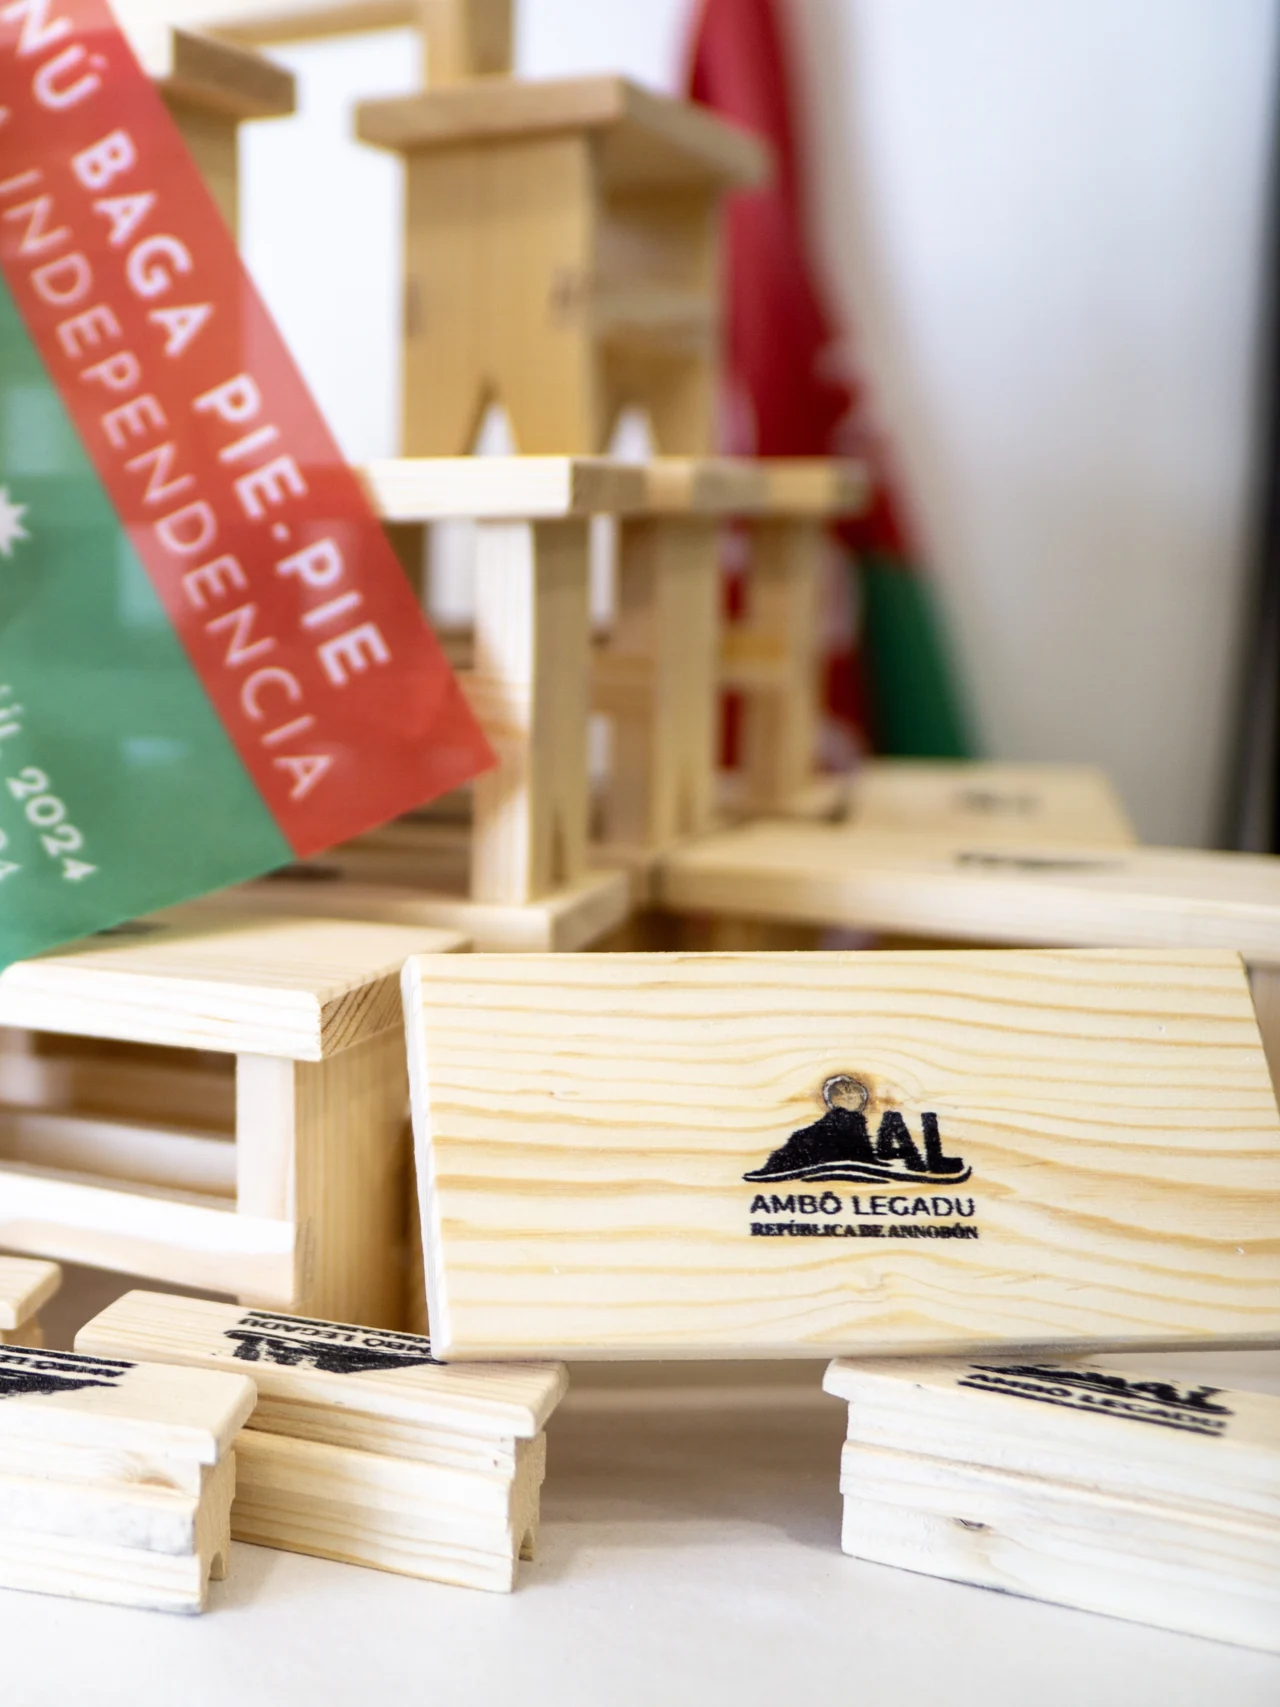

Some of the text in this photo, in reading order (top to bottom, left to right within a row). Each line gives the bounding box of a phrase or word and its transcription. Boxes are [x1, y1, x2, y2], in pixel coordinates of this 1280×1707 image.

[71, 129, 212, 357] BAGA
[194, 374, 392, 686] PIE-PIE
[7, 767, 100, 883] 2024
[872, 1111, 966, 1173] AL
[852, 1195, 975, 1217] LEGADU
[859, 1224, 886, 1238] DE
[237, 1318, 357, 1342] LEGADU
[361, 1337, 431, 1354] MBÔ
